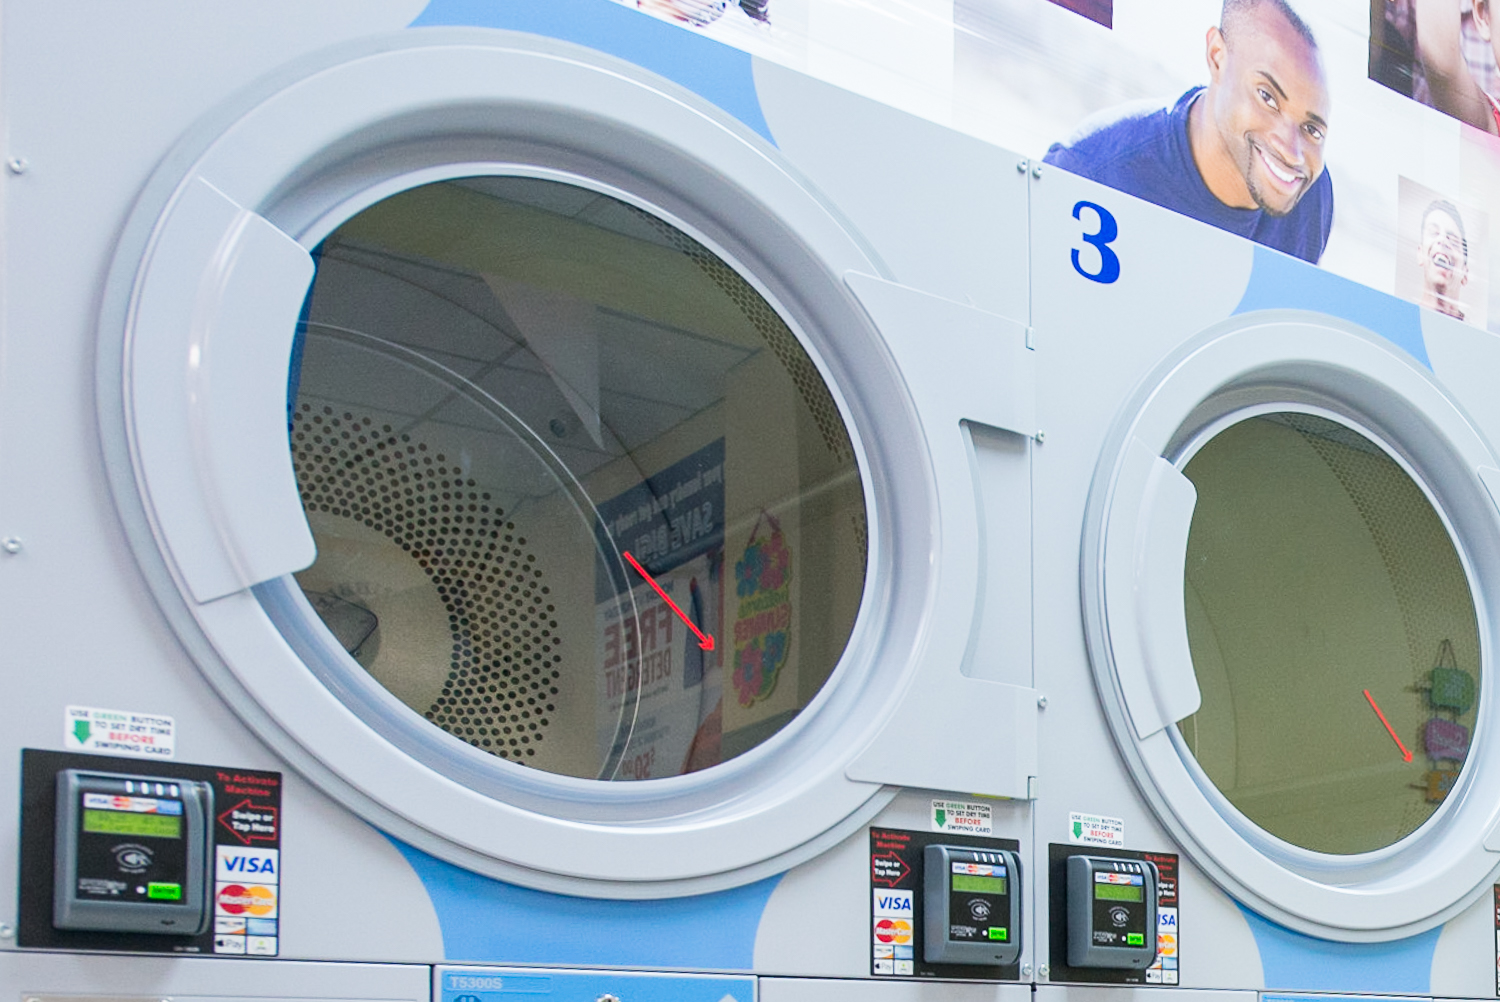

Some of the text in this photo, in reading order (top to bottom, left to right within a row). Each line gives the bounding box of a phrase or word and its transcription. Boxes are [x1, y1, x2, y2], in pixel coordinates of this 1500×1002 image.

[1071, 200, 1121, 285] 3
[70, 708, 171, 727] USE GREEN BUTTON
[111, 722, 125, 730] SET
[150, 727, 171, 736] TIME
[109, 731, 154, 745] BEFORE
[95, 740, 172, 756] SWIPING CARD
[217, 772, 278, 787] To Activate
[225, 784, 270, 797] Machine
[232, 809, 274, 823] Swipe or
[955, 817, 981, 826] BEFORE
[1101, 818, 1122, 826] BUTTON
[232, 821, 275, 834] Tap Here
[948, 824, 991, 834] SWIPING CARD
[882, 831, 910, 841] Activate
[1083, 836, 1107, 844] SWIPING
[1090, 830, 1114, 839] BEFORE
[876, 840, 905, 850] Machine
[222, 854, 275, 875] VISA
[875, 858, 892, 868] Swipe
[874, 867, 900, 877] Tap Here
[218, 894, 276, 907] MasterCard
[878, 896, 911, 910] VISA
[876, 927, 911, 936] MasterCard
[451, 976, 503, 990] T5300S
